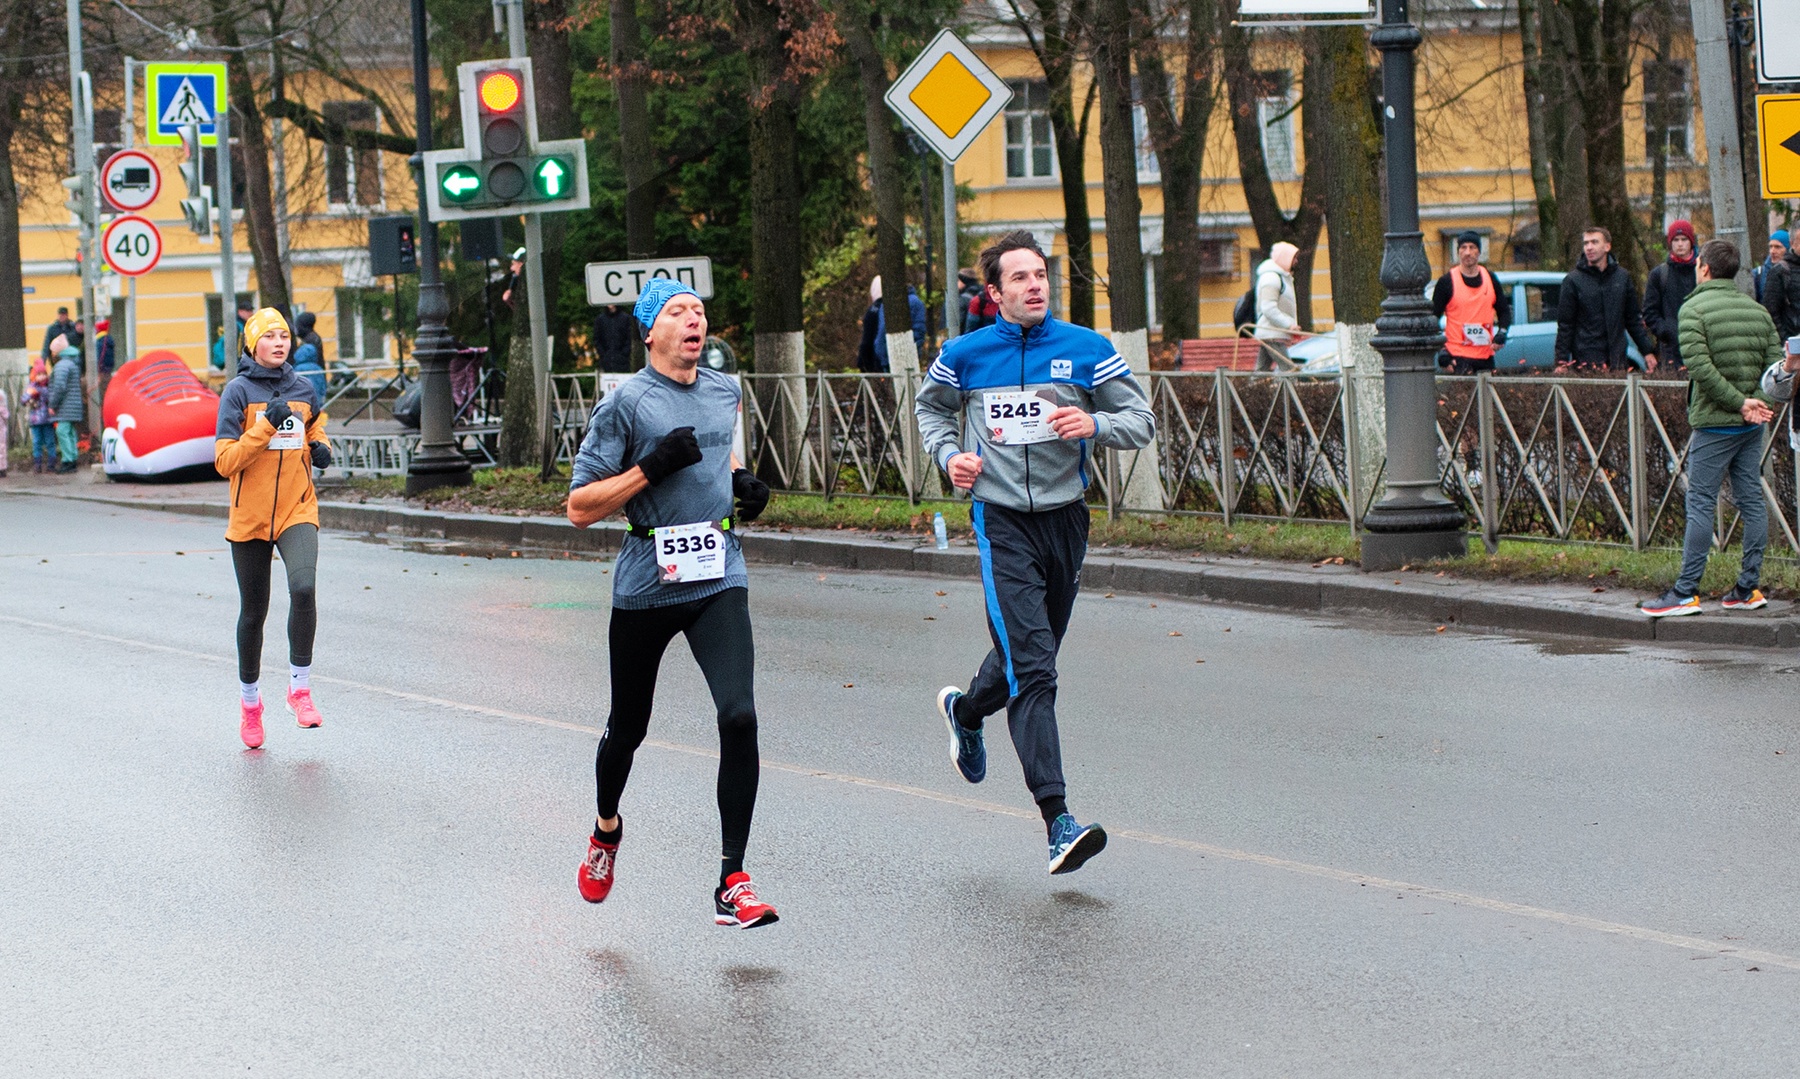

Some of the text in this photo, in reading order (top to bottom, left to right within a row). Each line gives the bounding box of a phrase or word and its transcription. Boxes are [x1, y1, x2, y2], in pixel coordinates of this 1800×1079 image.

[114, 233, 150, 257] 40
[990, 402, 1041, 419] 5245
[663, 533, 716, 555] 5336
